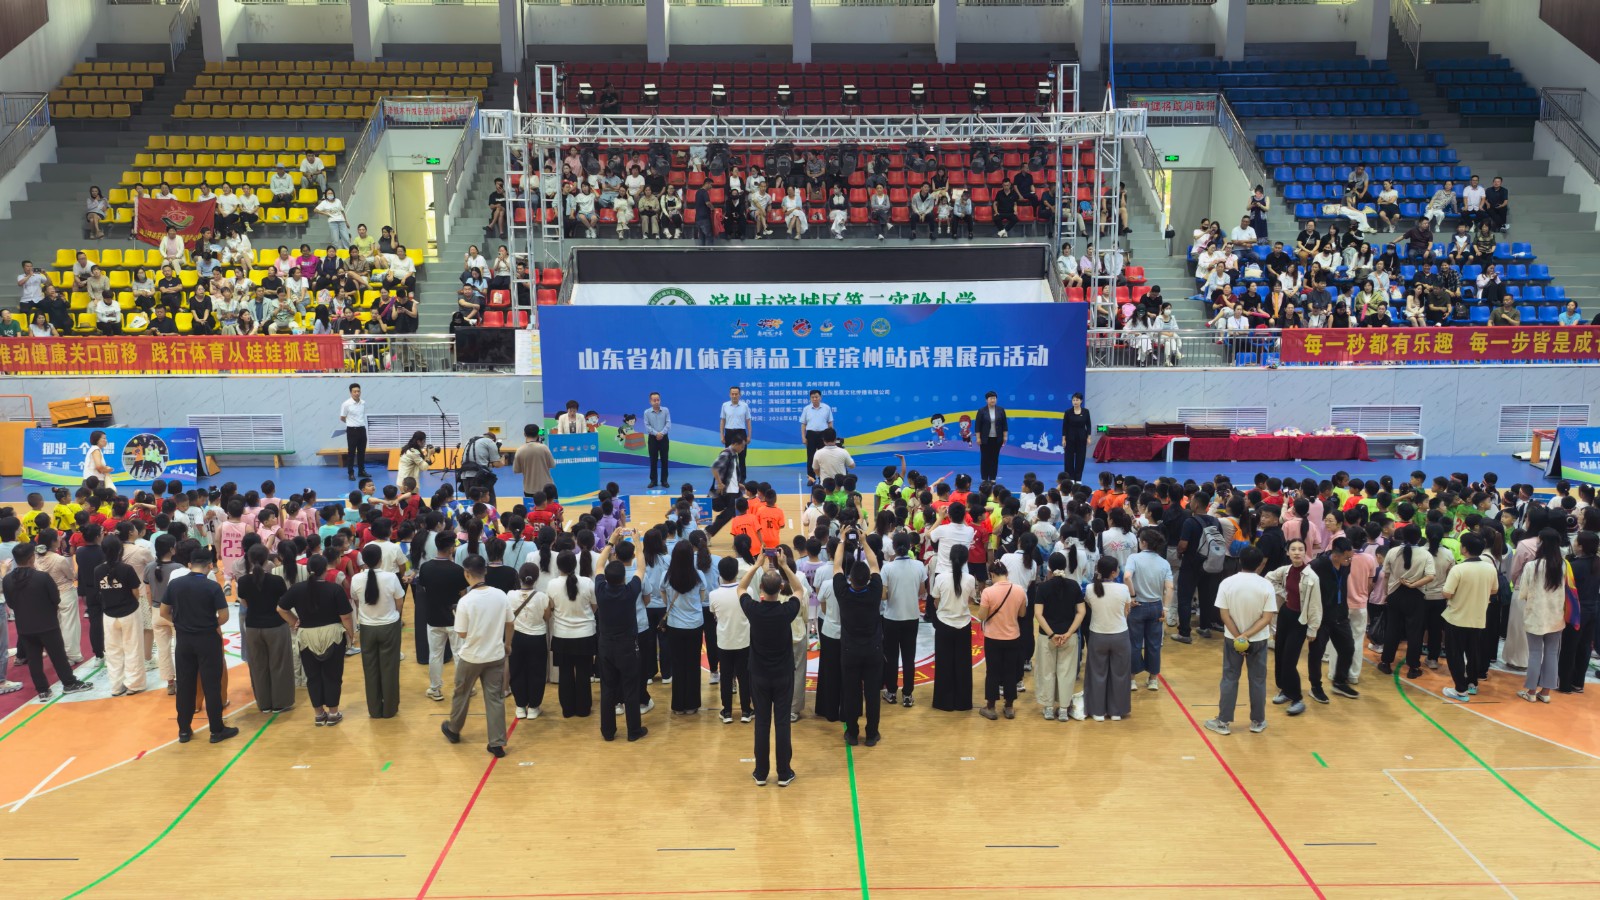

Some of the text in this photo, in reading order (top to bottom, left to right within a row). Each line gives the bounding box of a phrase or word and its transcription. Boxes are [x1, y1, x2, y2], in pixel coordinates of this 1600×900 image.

[0, 340, 321, 365] 推动健康关口前移 践行体育从娃娃抓起
[1303, 332, 1453, 356] 每一秒都有乐趣
[578, 344, 1050, 371] 山东省幼儿体育精品工程滨州站成果展示活动
[223, 539, 245, 558] 23
